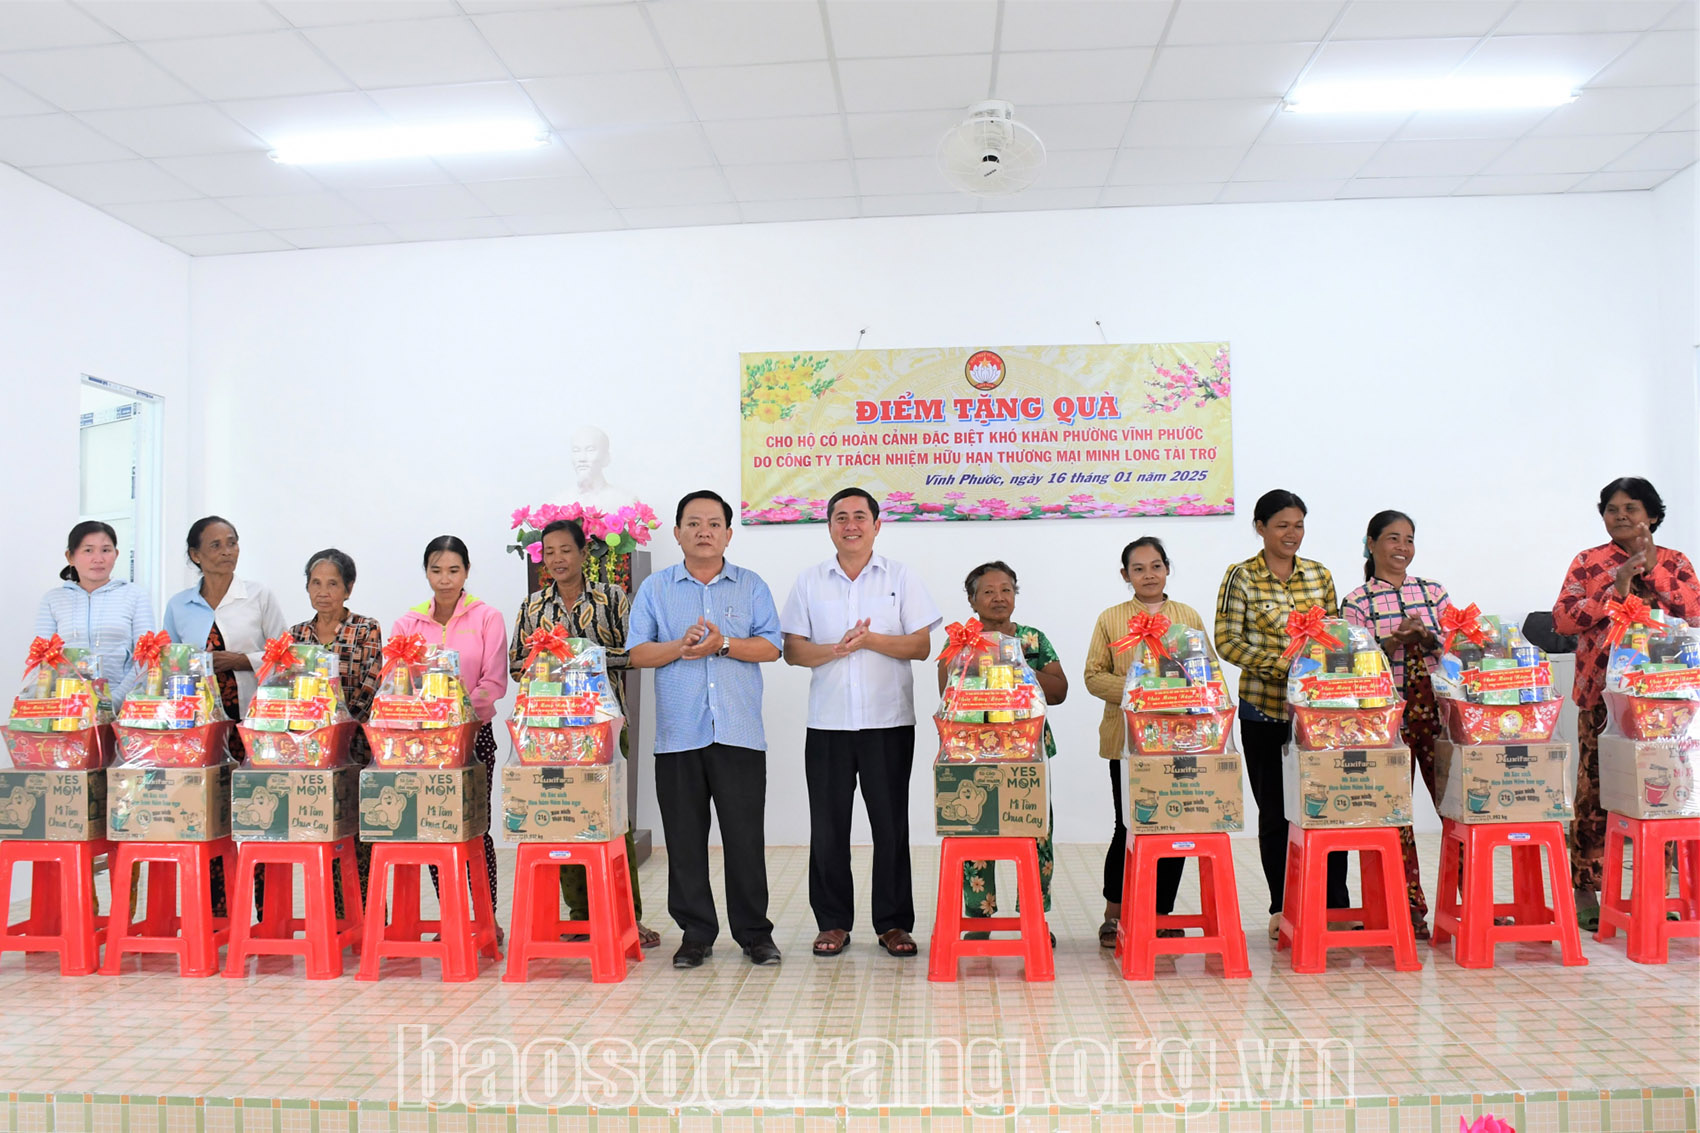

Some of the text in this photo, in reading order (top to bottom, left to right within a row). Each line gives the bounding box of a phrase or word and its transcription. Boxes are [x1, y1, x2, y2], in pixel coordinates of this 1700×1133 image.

[855, 391, 1121, 426] ĐIỂM TẶNG QUÀ
[766, 425, 1203, 450] CHO HỘ CÓ HOÀN CẢNH ĐẶC BIỆT KHÓ KHĂN PHƯỜNG VĨNH PHƯỚC
[754, 446, 1217, 468] DO CÔNG TY TRÁCH NHIỆM HỮU HẠN THƯƠNG MẠI MINH LONG TÀI TRỢ
[925, 470, 1209, 486] Vĩnh Phước, ngày 16 tháng 01 năm 2025
[1011, 767, 1037, 777] YES
[56, 775, 79, 785] YES
[300, 774, 324, 784] YES
[428, 774, 453, 784] YES
[1007, 778, 1040, 789] MOM
[53, 785, 82, 796] MOM
[297, 785, 327, 796] MOM
[425, 785, 456, 796] MOM
